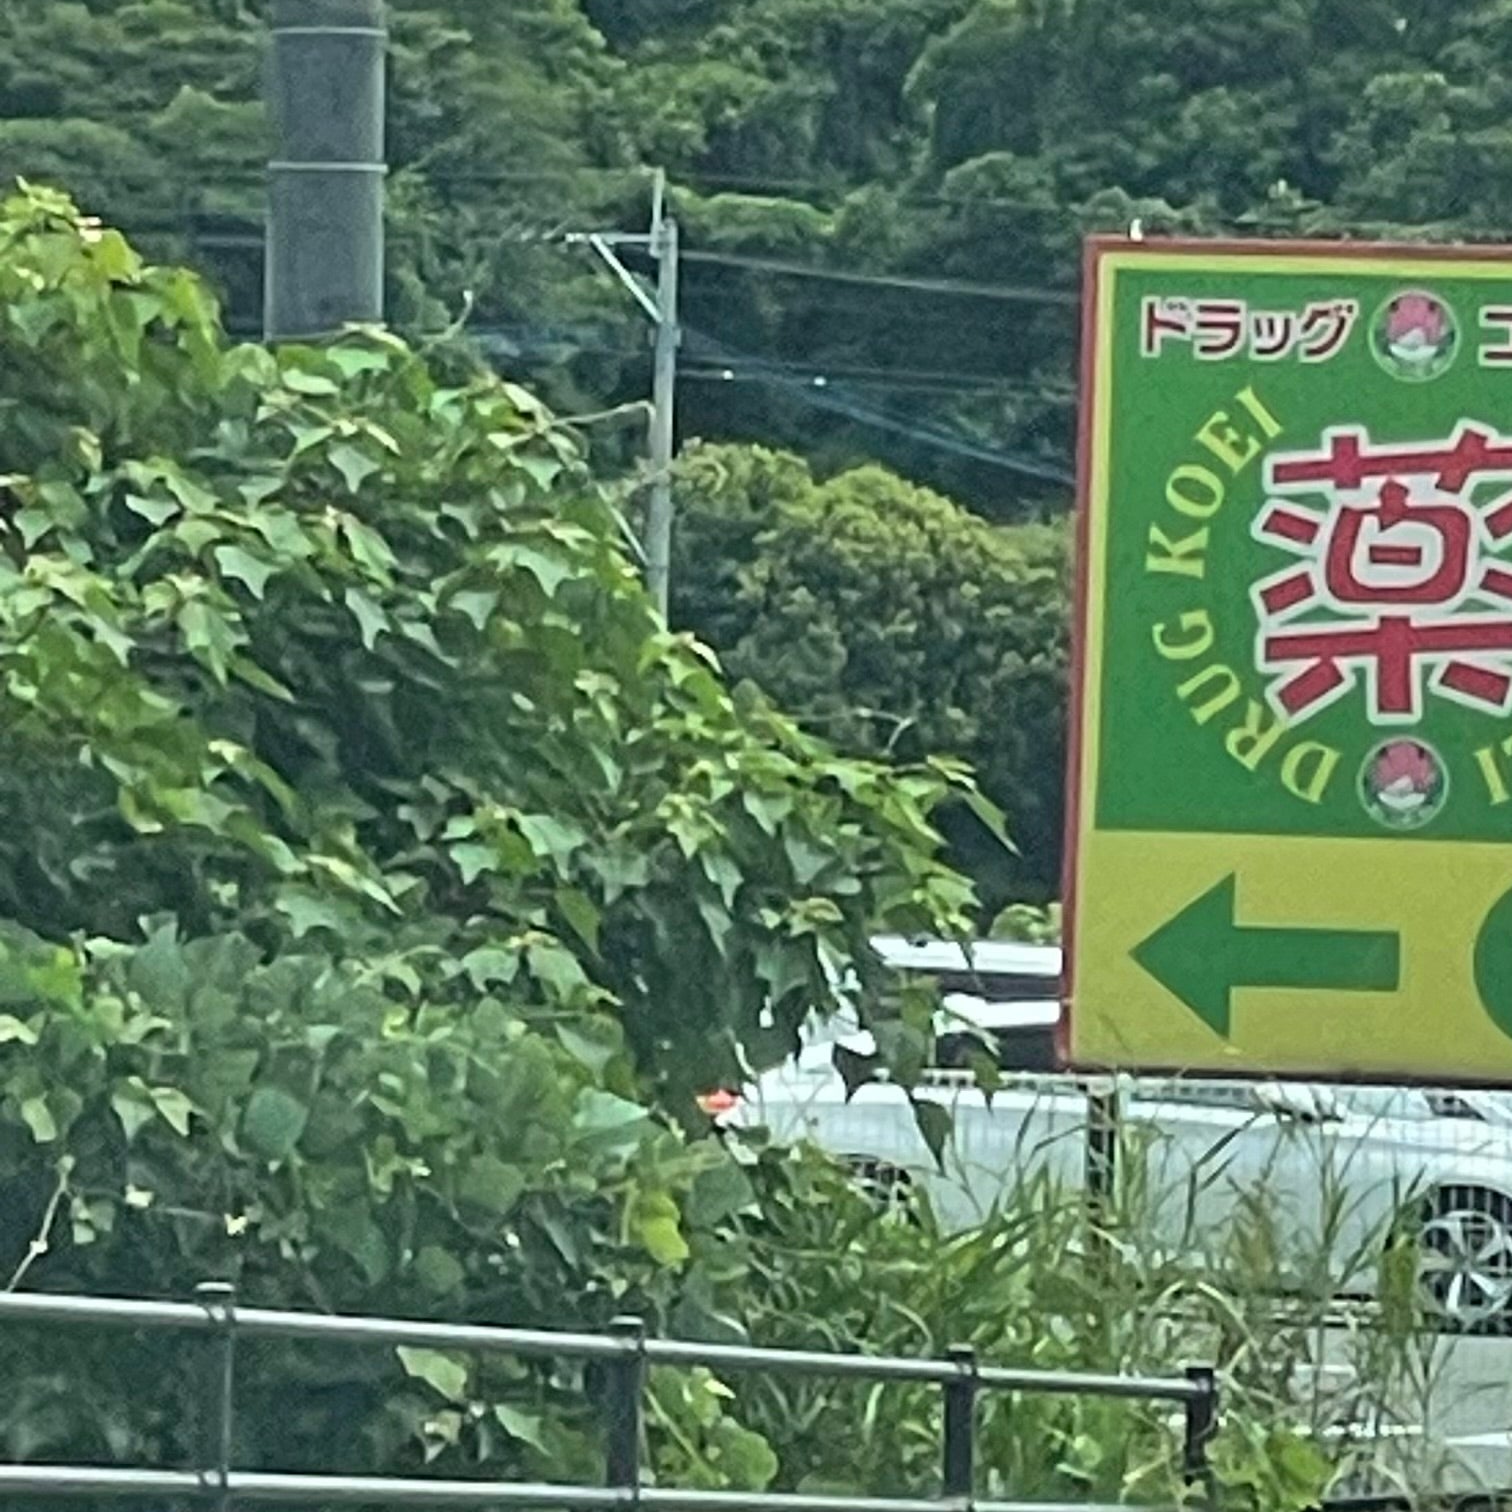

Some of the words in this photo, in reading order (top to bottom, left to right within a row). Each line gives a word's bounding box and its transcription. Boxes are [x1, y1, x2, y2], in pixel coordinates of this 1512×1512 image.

[1141, 297, 1358, 360] ドラッグ
[1145, 386, 1285, 578] KOEI
[1153, 611, 1341, 805] DRUG
